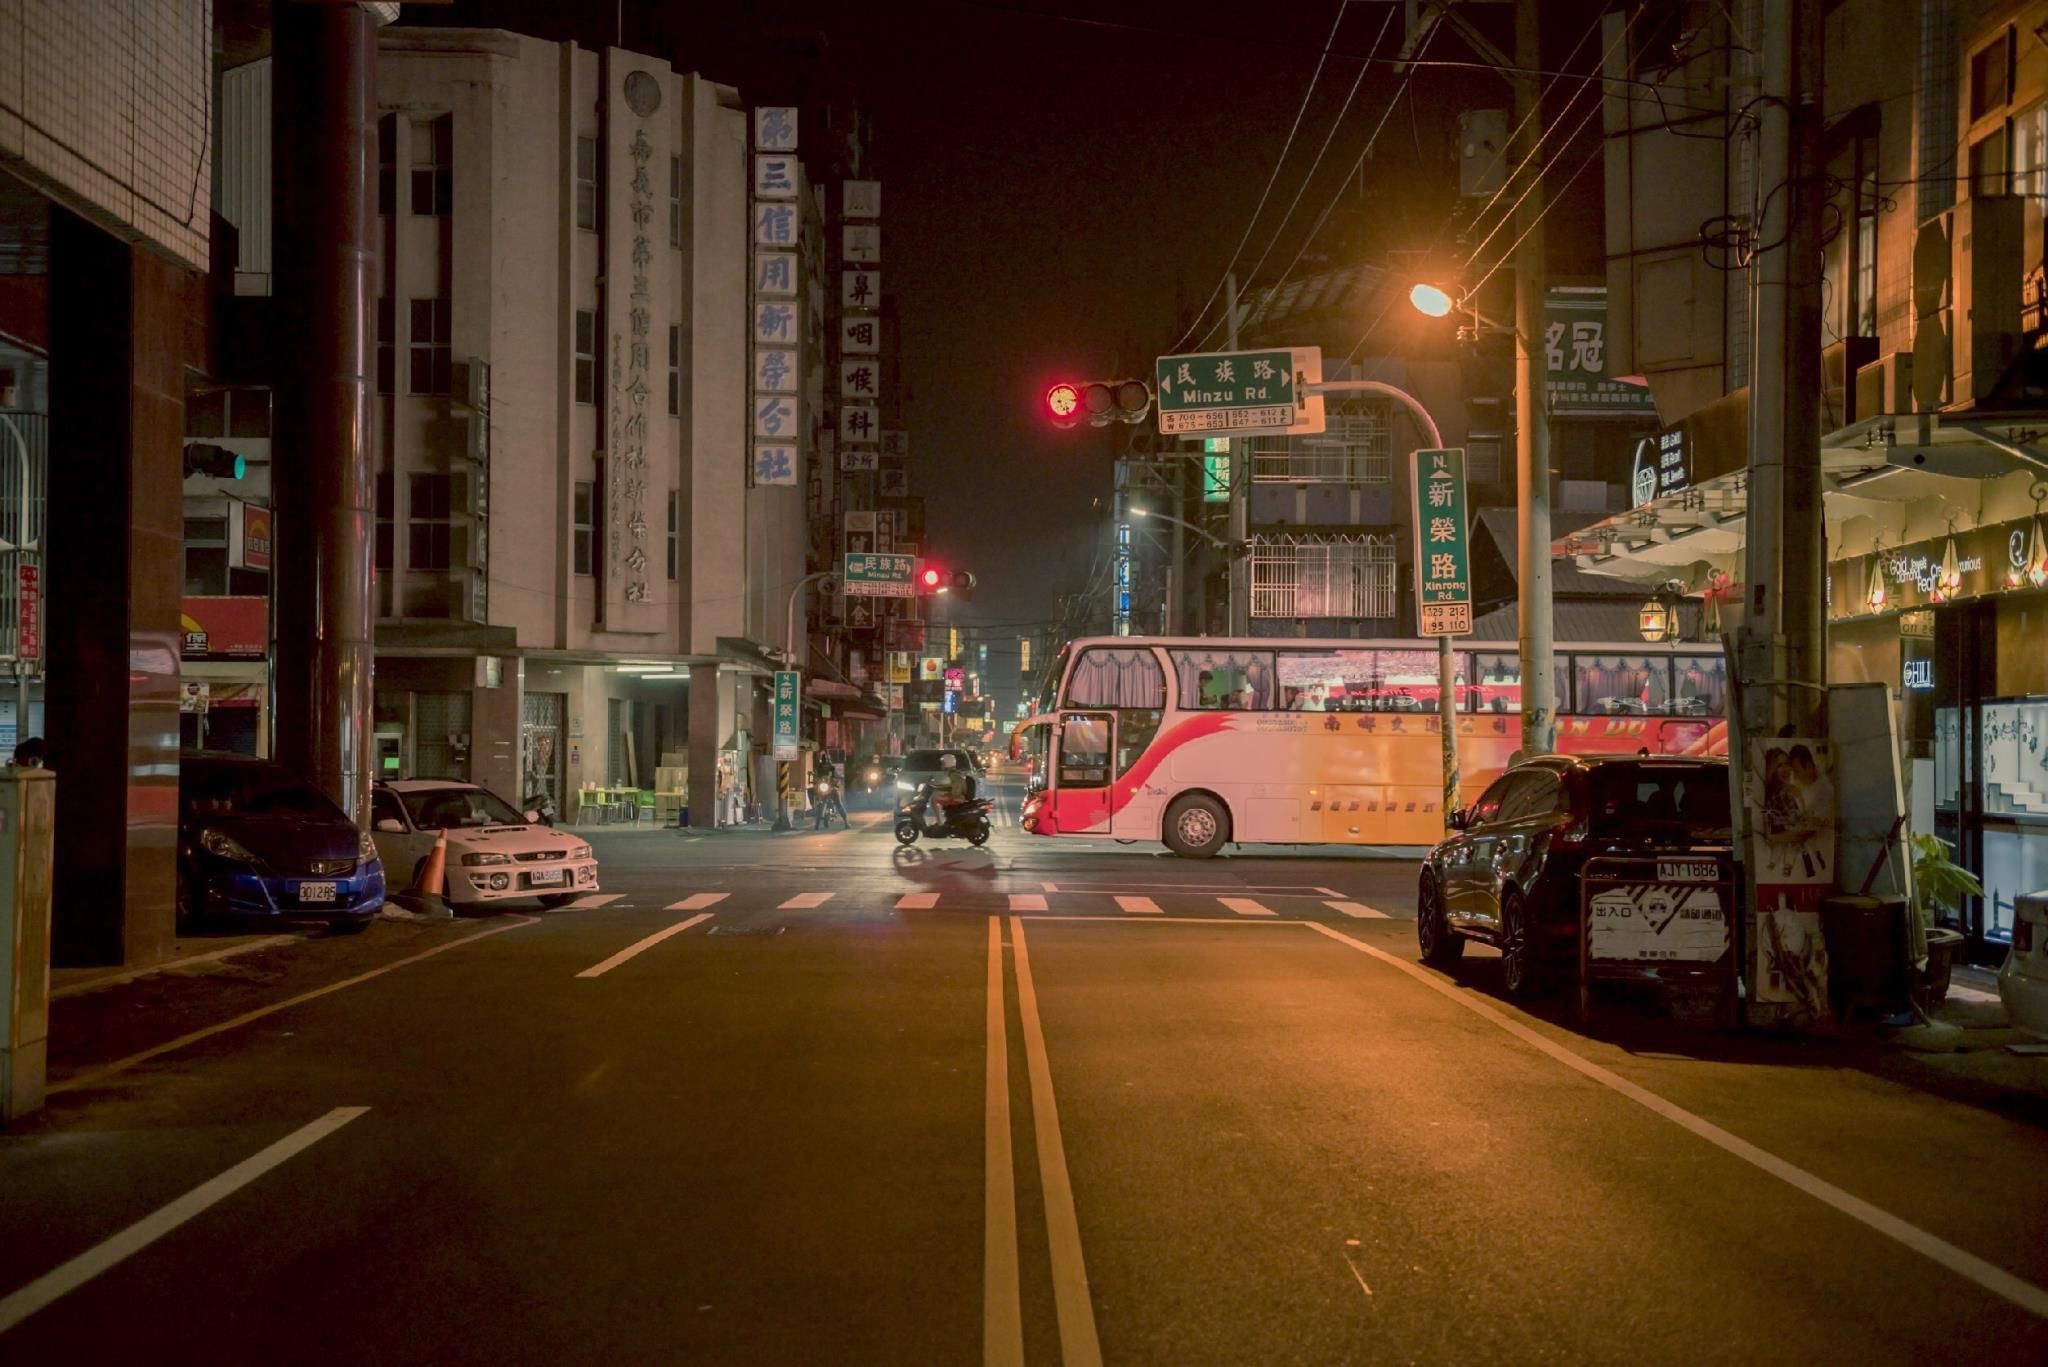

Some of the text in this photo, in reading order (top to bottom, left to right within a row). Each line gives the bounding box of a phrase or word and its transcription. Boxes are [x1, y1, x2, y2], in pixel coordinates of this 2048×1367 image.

[1177, 359, 1277, 386] 民族路
[1184, 386, 1272, 404] Minzu Rd.
[1433, 455, 1447, 469] N.
[1428, 481, 1457, 579] 新榮路
[864, 556, 907, 572] 民族路
[1890, 556, 1907, 575] Gold
[1425, 581, 1466, 593] Xinrong
[1438, 591, 1455, 601] Rd.
[779, 686, 792, 735] 新榮路
[1595, 906, 1632, 918] 出入口
